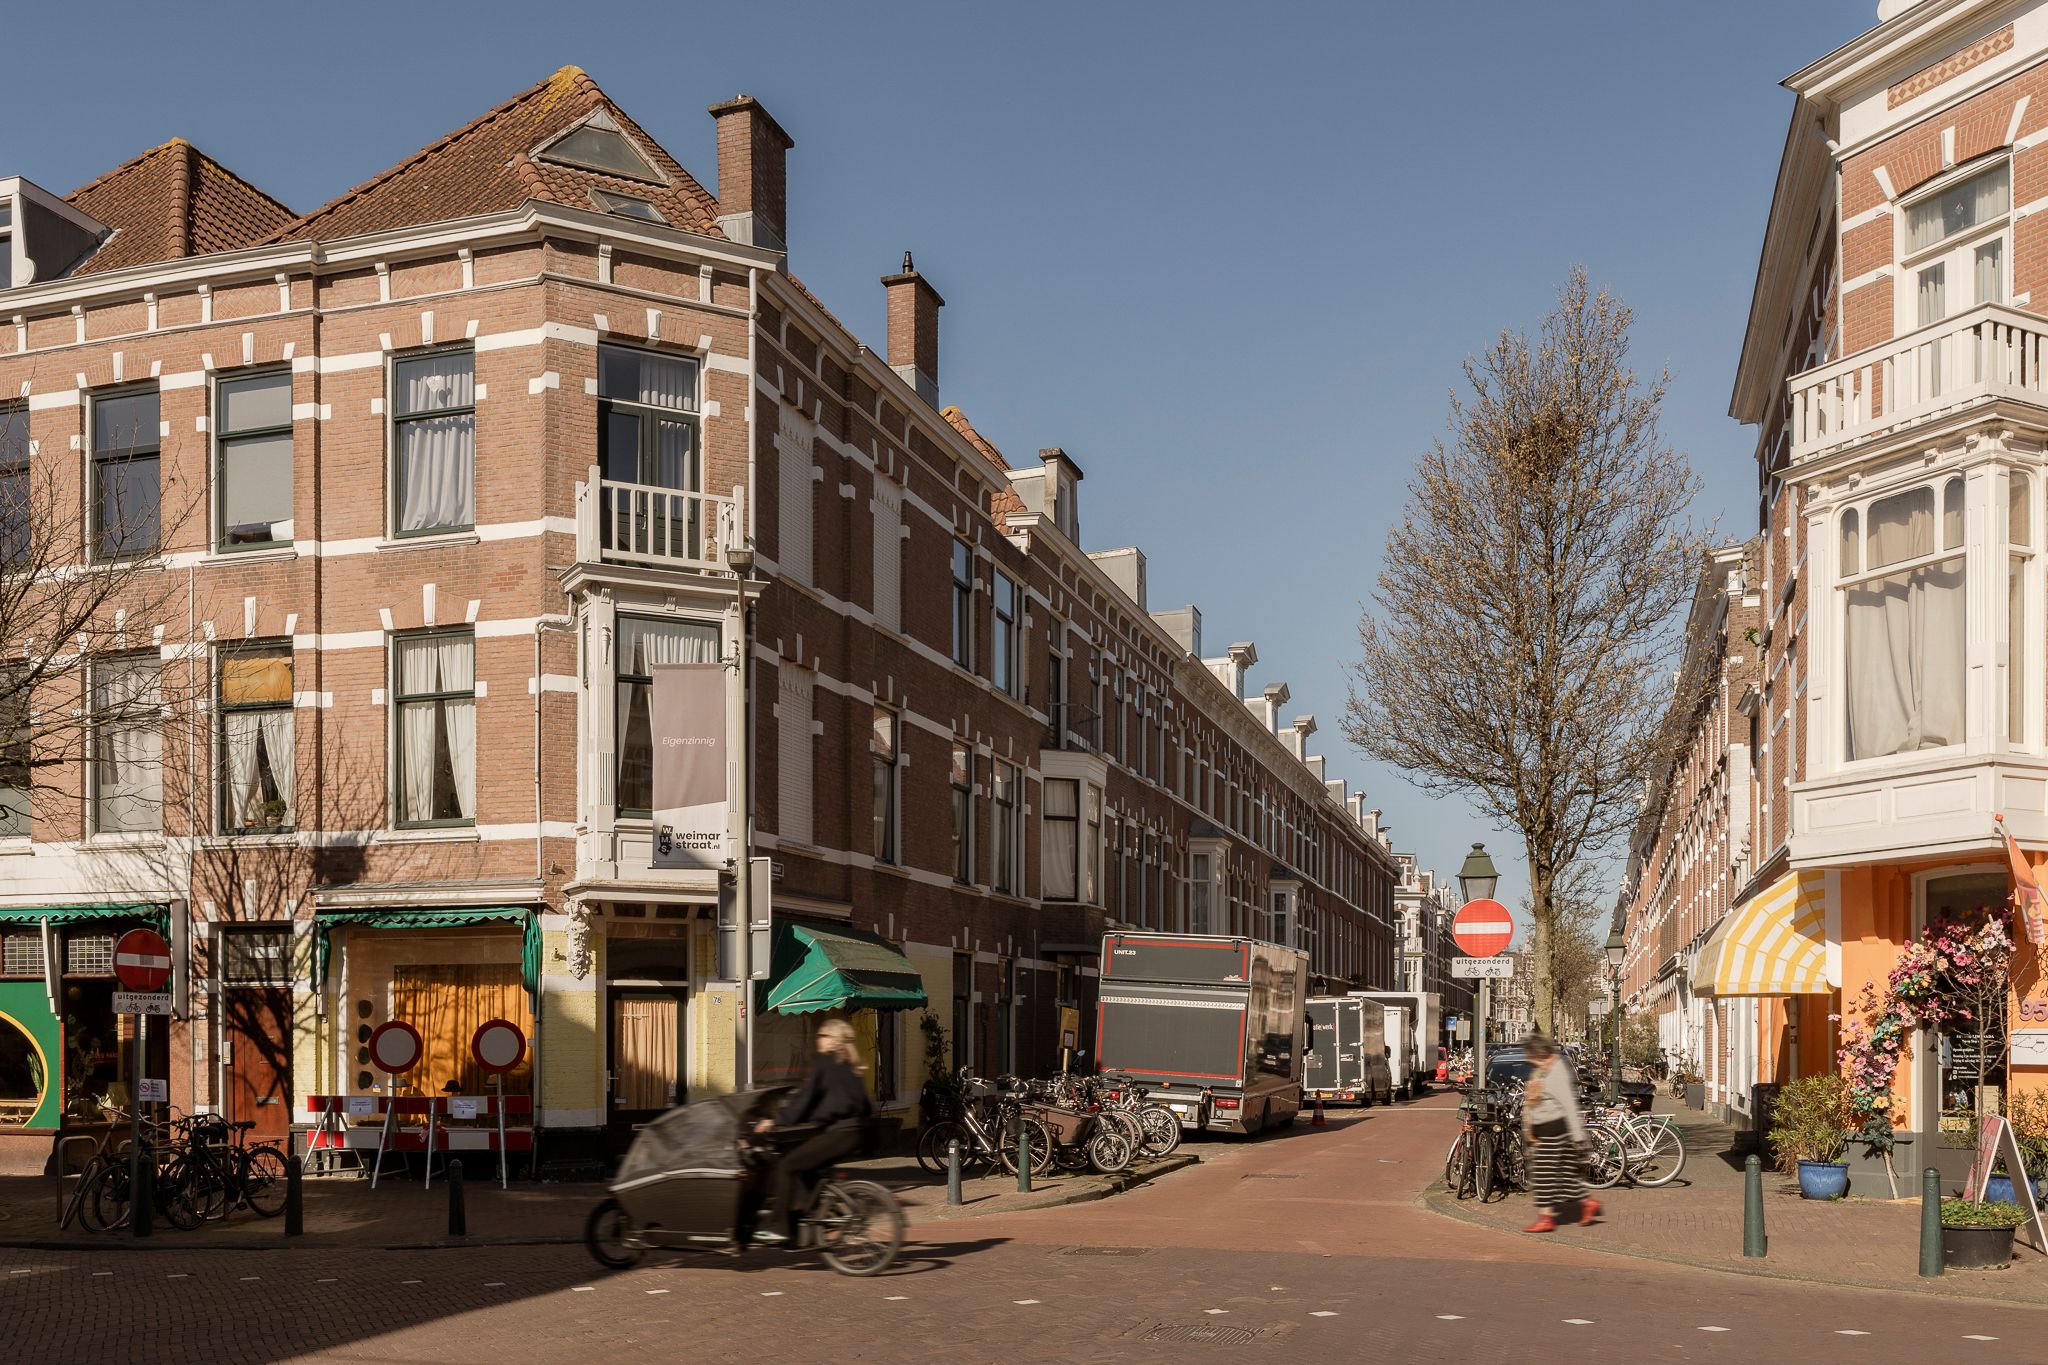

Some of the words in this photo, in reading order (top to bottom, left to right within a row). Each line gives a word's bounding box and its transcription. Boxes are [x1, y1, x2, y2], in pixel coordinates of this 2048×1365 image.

[662, 736, 716, 747] Eigenzinnig
[675, 830, 721, 841] weimar
[675, 841, 720, 850] straat.nl
[1456, 958, 1510, 966] uitgezonderd
[117, 993, 169, 1002] uitgezonderd
